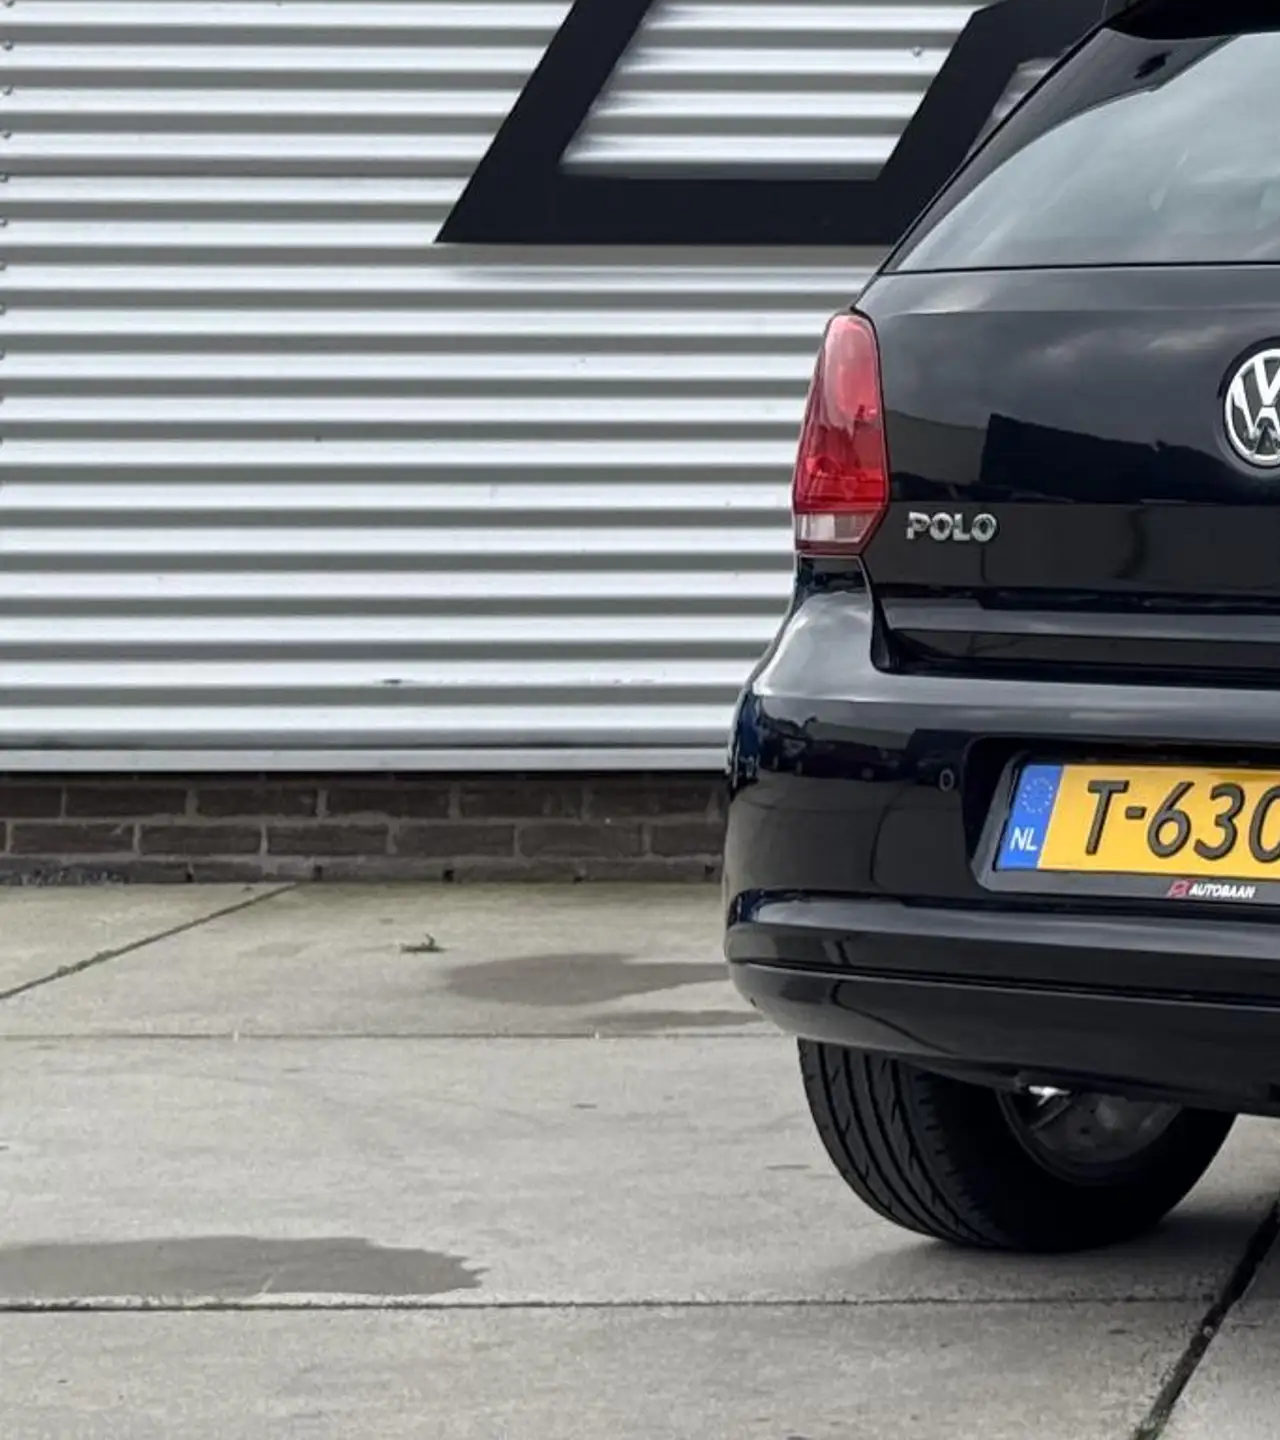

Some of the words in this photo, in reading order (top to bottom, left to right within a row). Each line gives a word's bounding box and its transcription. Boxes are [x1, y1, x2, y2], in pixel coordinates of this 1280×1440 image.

[906, 511, 998, 542] POLO
[1009, 826, 1039, 852] NL
[1188, 882, 1256, 899] AUTOBAAN
